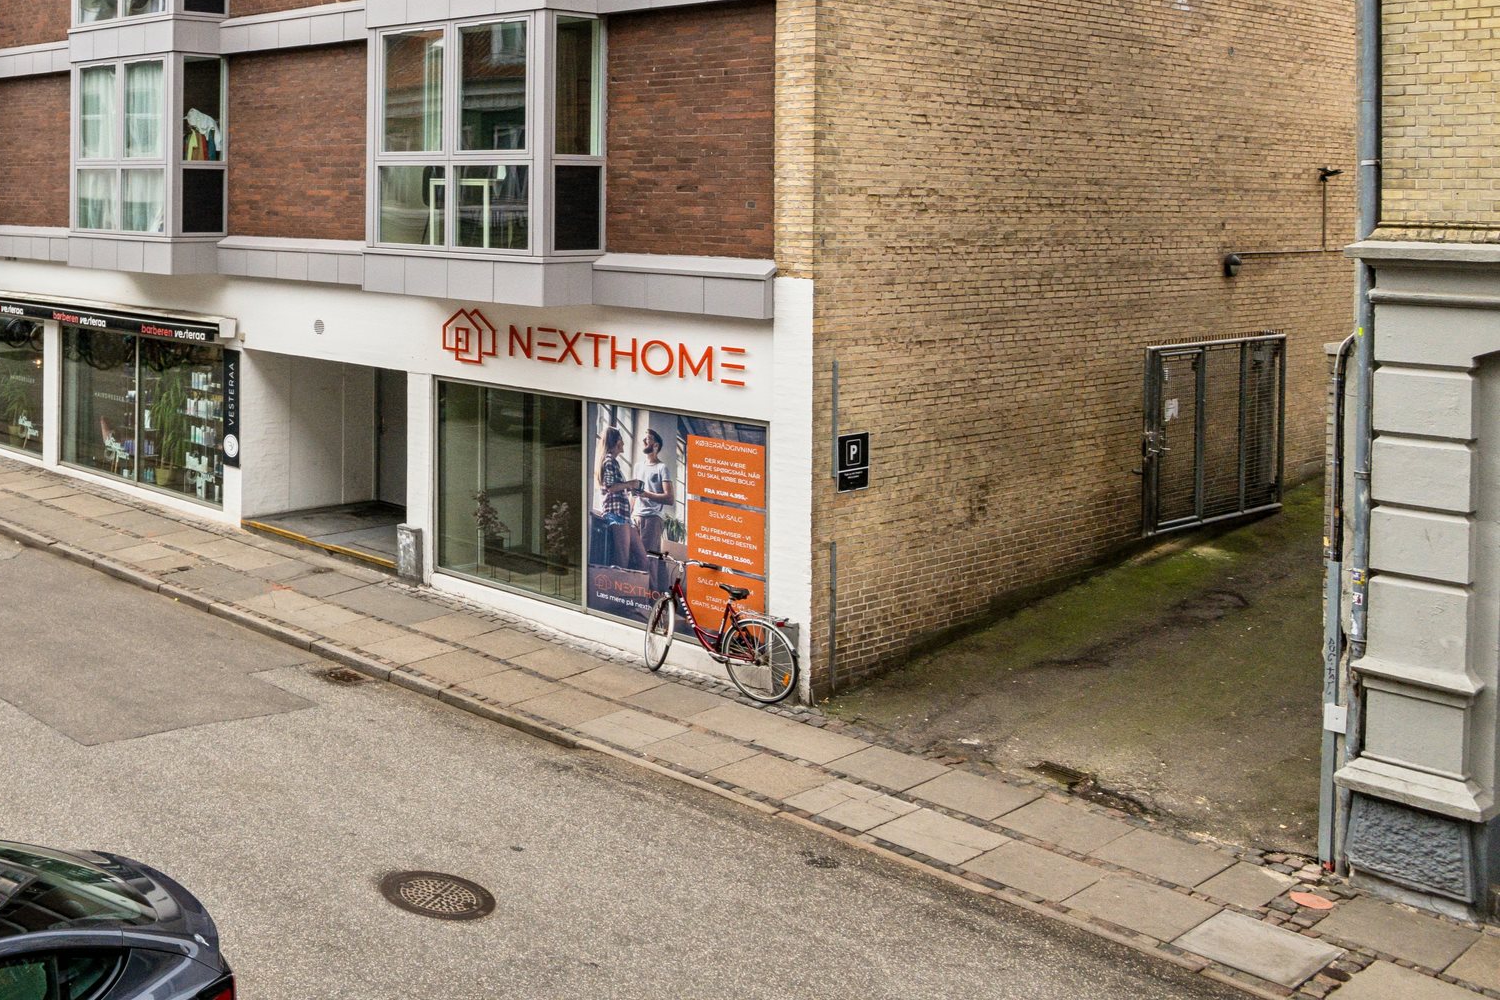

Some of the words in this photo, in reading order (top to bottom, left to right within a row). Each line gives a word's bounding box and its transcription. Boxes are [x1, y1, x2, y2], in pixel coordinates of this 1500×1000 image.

[0, 306, 24, 315] vesteraa
[52, 311, 79, 324] barberen
[79, 316, 106, 328] vesteraa
[141, 324, 173, 337] barberen
[174, 329, 206, 341] vesteraa
[508, 324, 747, 388] NEXTHOME
[695, 440, 758, 455] KØBERRÅDGIVNING
[850, 444, 858, 461] P
[692, 463, 713, 471] MANGE
[713, 466, 747, 478] SPØRGSMÅL
[747, 472, 761, 480] NÅR
[729, 461, 747, 469] VÆRE
[706, 473, 720, 481] SKAL
[721, 475, 737, 484] KØBE
[737, 478, 756, 487] BOLIG
[704, 487, 715, 495] FRA
[716, 489, 729, 497] KUN
[708, 510, 743, 523] SELV-SALG
[710, 527, 741, 539] FREMVISER
[695, 533, 721, 542] HJÆLPER
[721, 538, 735, 546] MED
[735, 540, 757, 551] RESTEN
[697, 547, 712, 555] FAST
[712, 550, 733, 561] SALÆR
[697, 576, 714, 586] SALG
[614, 580, 665, 601] NEXTHO
[596, 590, 609, 600] Læs
[609, 595, 626, 605] mere
[626, 599, 634, 609] på
[691, 599, 710, 609] GRATIS
[705, 595, 723, 604] START
